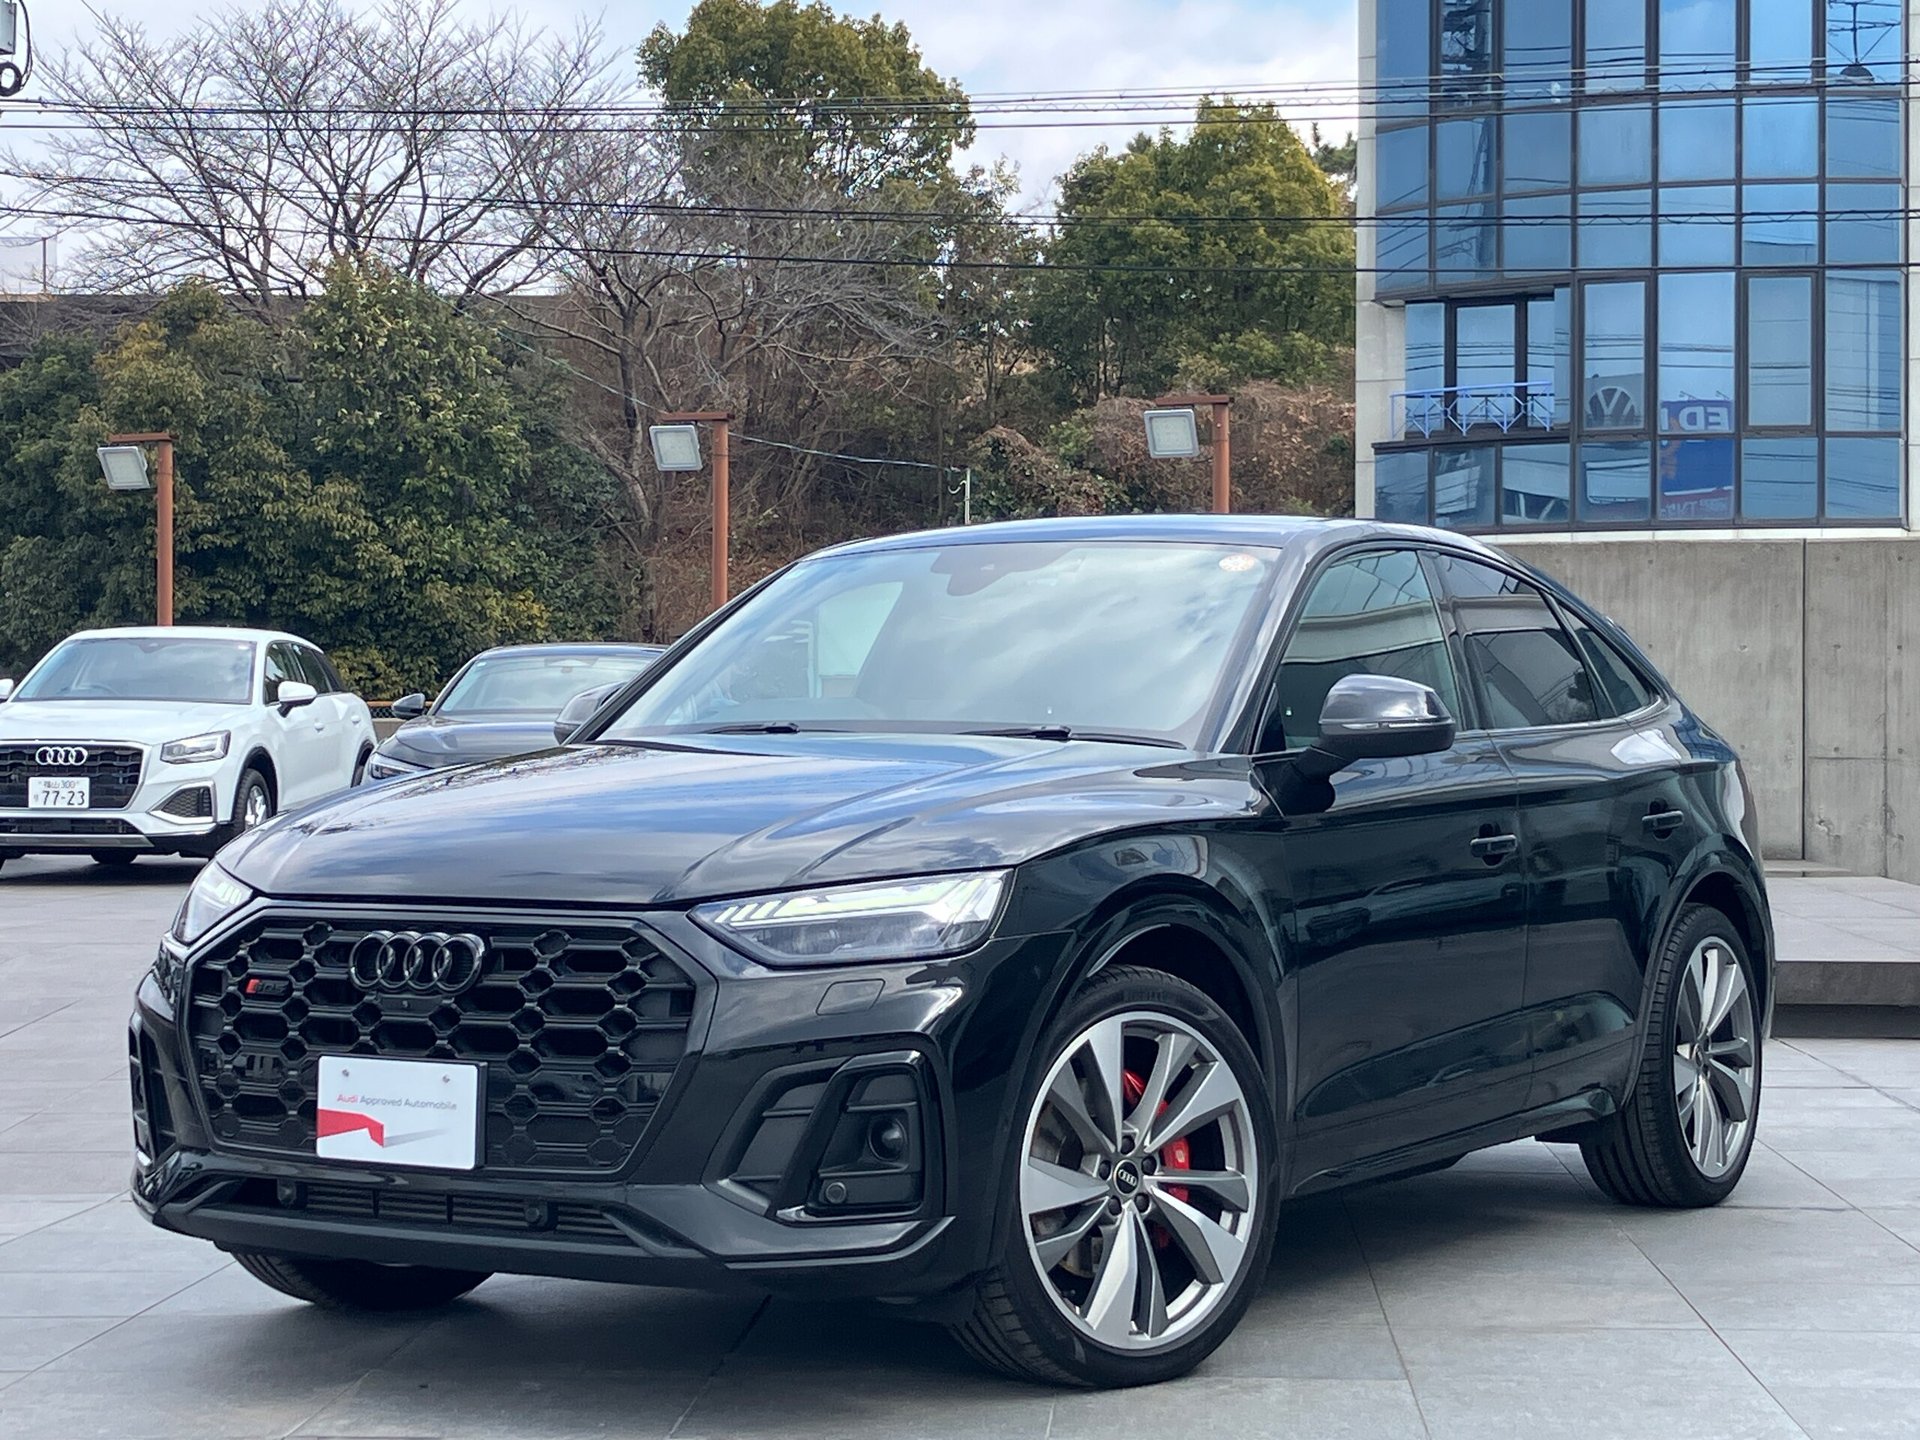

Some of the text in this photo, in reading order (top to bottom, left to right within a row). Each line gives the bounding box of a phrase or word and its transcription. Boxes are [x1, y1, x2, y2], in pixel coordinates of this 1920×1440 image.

[61, 780, 76, 789] 300
[42, 790, 85, 806] 77-23
[337, 1094, 457, 1110] Audi Approved Automobile
